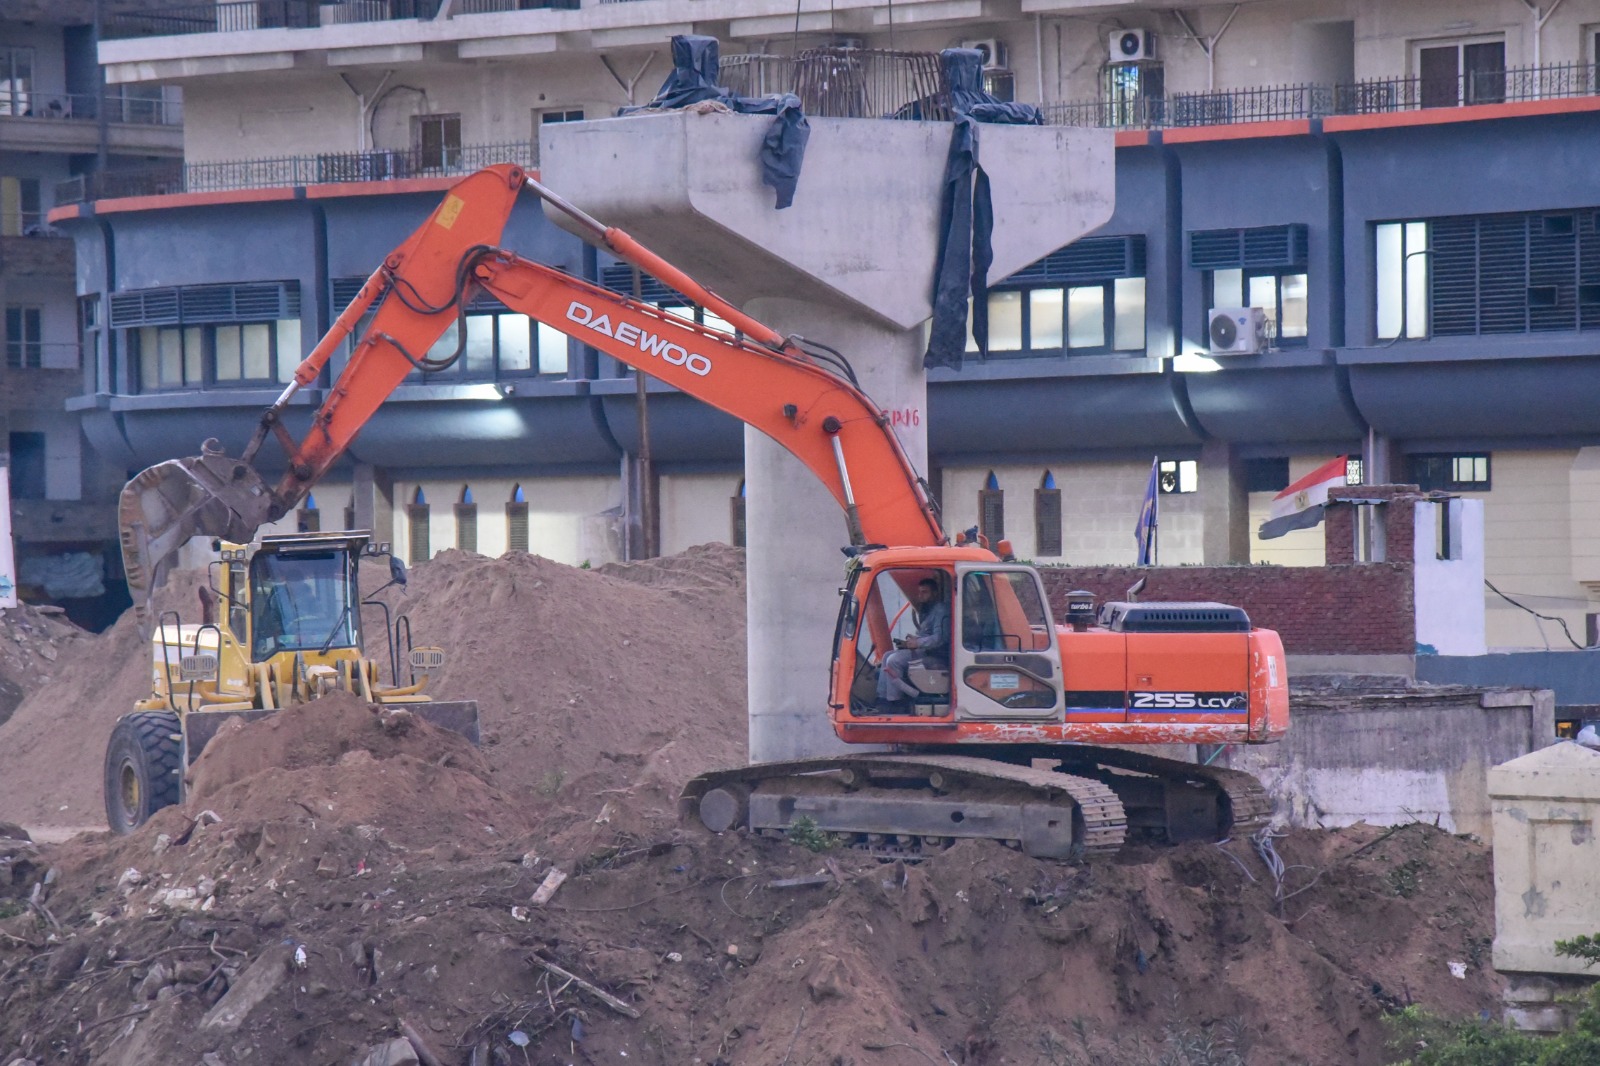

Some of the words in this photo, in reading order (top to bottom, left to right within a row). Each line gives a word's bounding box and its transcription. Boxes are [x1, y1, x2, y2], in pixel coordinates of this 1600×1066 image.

[566, 301, 712, 376] DAEWOO
[1134, 693, 1196, 708] 255
[1198, 698, 1231, 708] LCV
